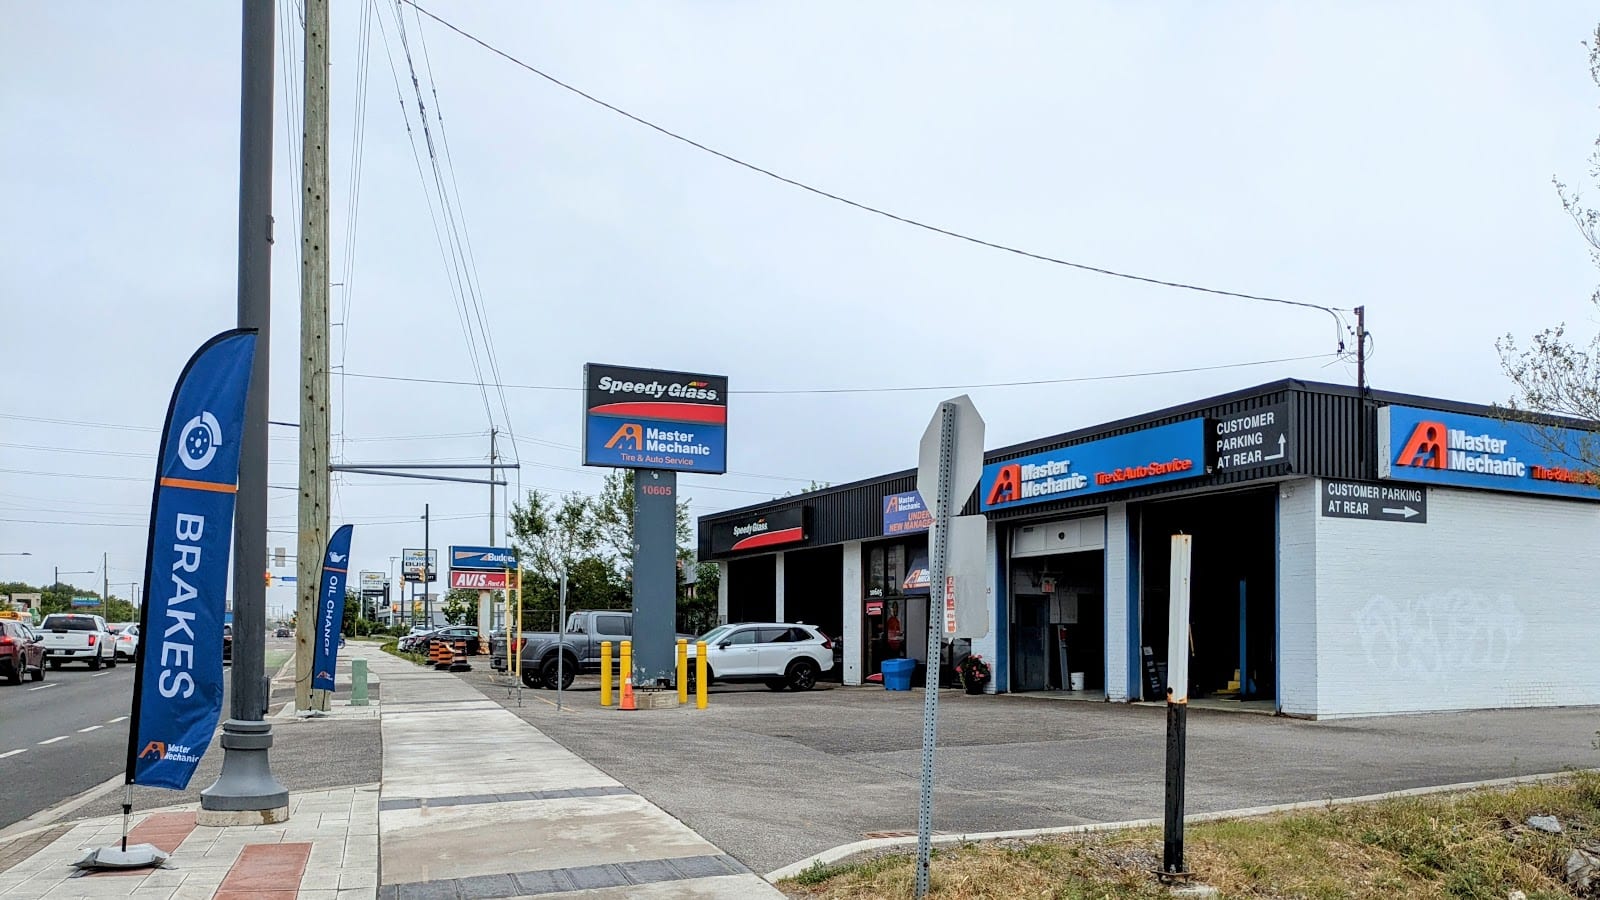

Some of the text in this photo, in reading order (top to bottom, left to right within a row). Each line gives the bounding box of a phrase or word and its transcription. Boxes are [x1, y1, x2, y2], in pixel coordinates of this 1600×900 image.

[598, 376, 718, 400] Speedy Glass
[1216, 412, 1275, 435] CUSTOMER
[646, 427, 694, 443] Master
[1216, 432, 1263, 452] PARKING
[1451, 429, 1507, 454] Master
[646, 440, 711, 455] Mechanic
[621, 453, 694, 466] Tire & Auto Service
[1217, 450, 1262, 470] AT REAR
[1451, 451, 1526, 477] Mechanic
[1021, 459, 1070, 481] Master
[1095, 471, 1114, 485] Tire
[1124, 466, 1149, 480] Auto
[1148, 458, 1193, 476] Service
[642, 485, 672, 496] 10605
[1021, 472, 1087, 498] Mechanic
[1328, 483, 1422, 502] CUSTOMER PARKING
[899, 496, 915, 504] Master
[899, 502, 921, 511] Mechanic
[1328, 500, 1369, 515] AT REAR
[908, 510, 930, 520] UNDER
[733, 522, 768, 537] Speedy Glass
[889, 522, 903, 533] NEW
[327, 575, 338, 597] OIL
[456, 573, 487, 587] AVIS
[158, 512, 204, 699] BRAKES
[323, 600, 335, 656] CHANGE
